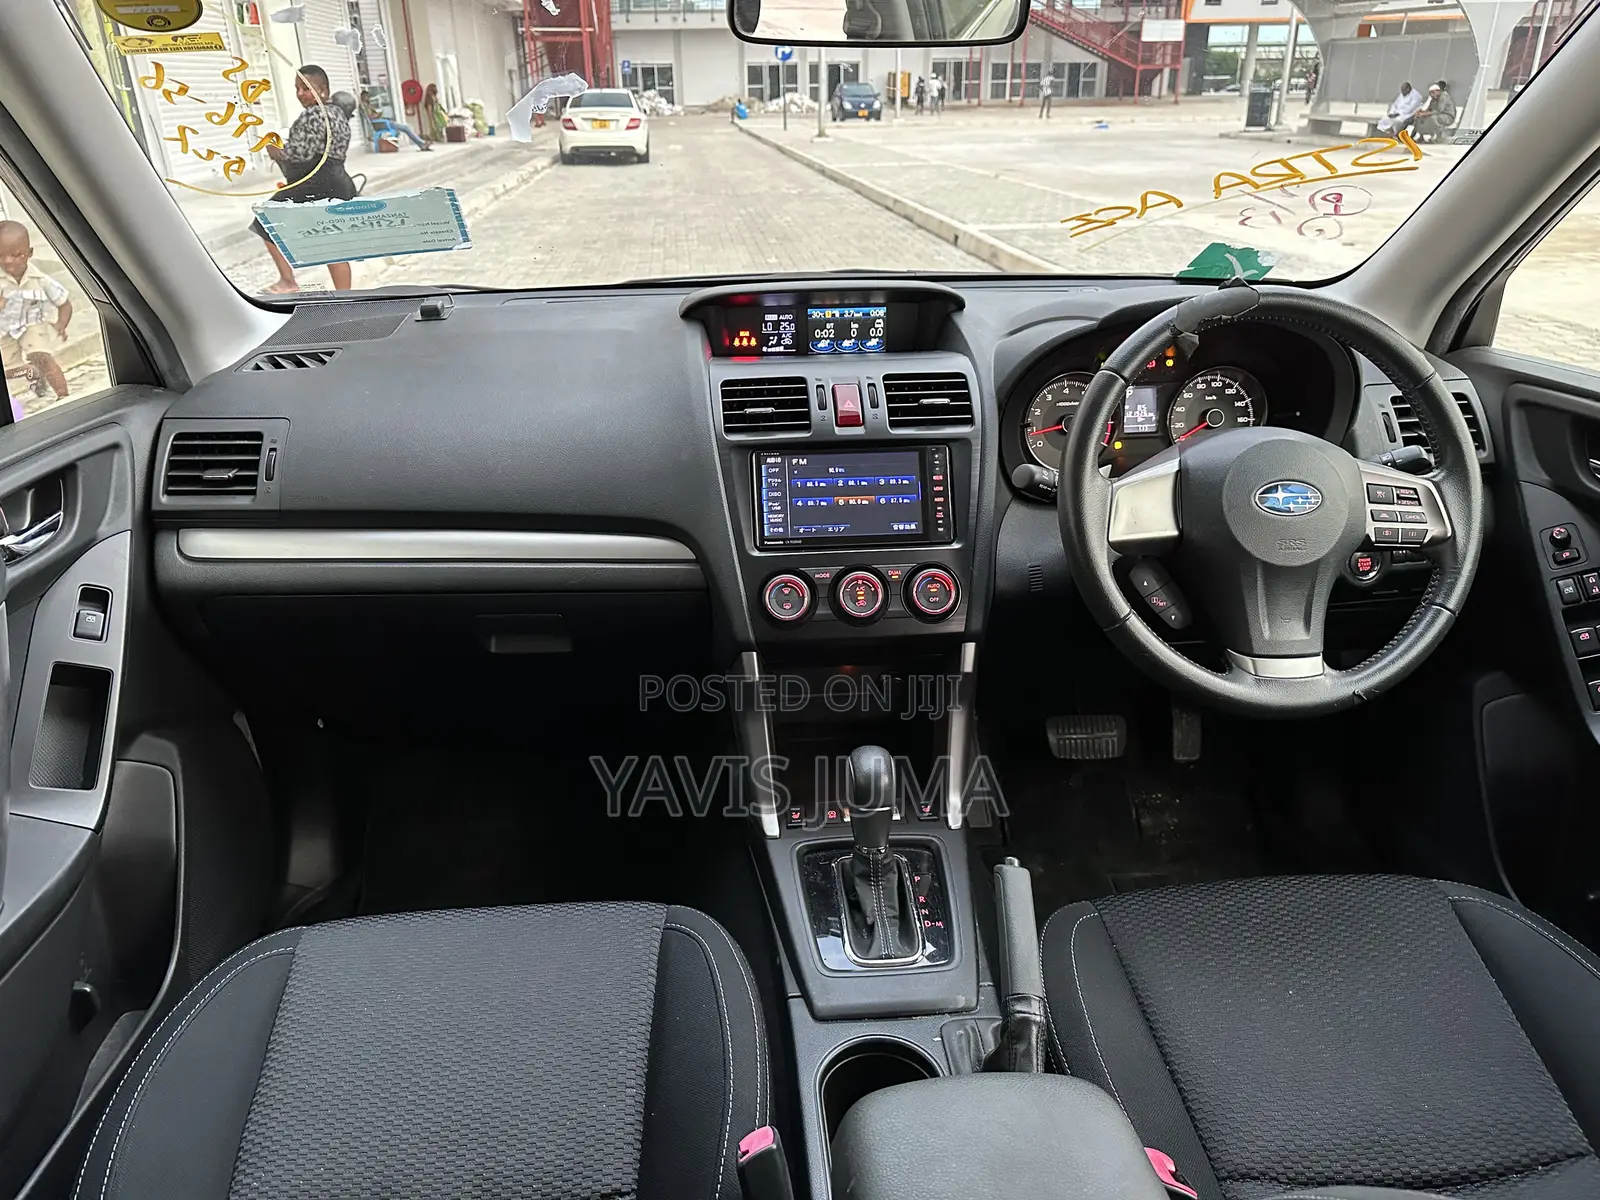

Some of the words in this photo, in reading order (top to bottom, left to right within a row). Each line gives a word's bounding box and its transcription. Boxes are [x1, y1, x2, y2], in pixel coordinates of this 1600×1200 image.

[762, 322, 772, 331] LO
[780, 322, 795, 330] 25.0
[814, 329, 834, 338] 0:02
[850, 328, 858, 338] 0
[870, 328, 884, 337] 0.0
